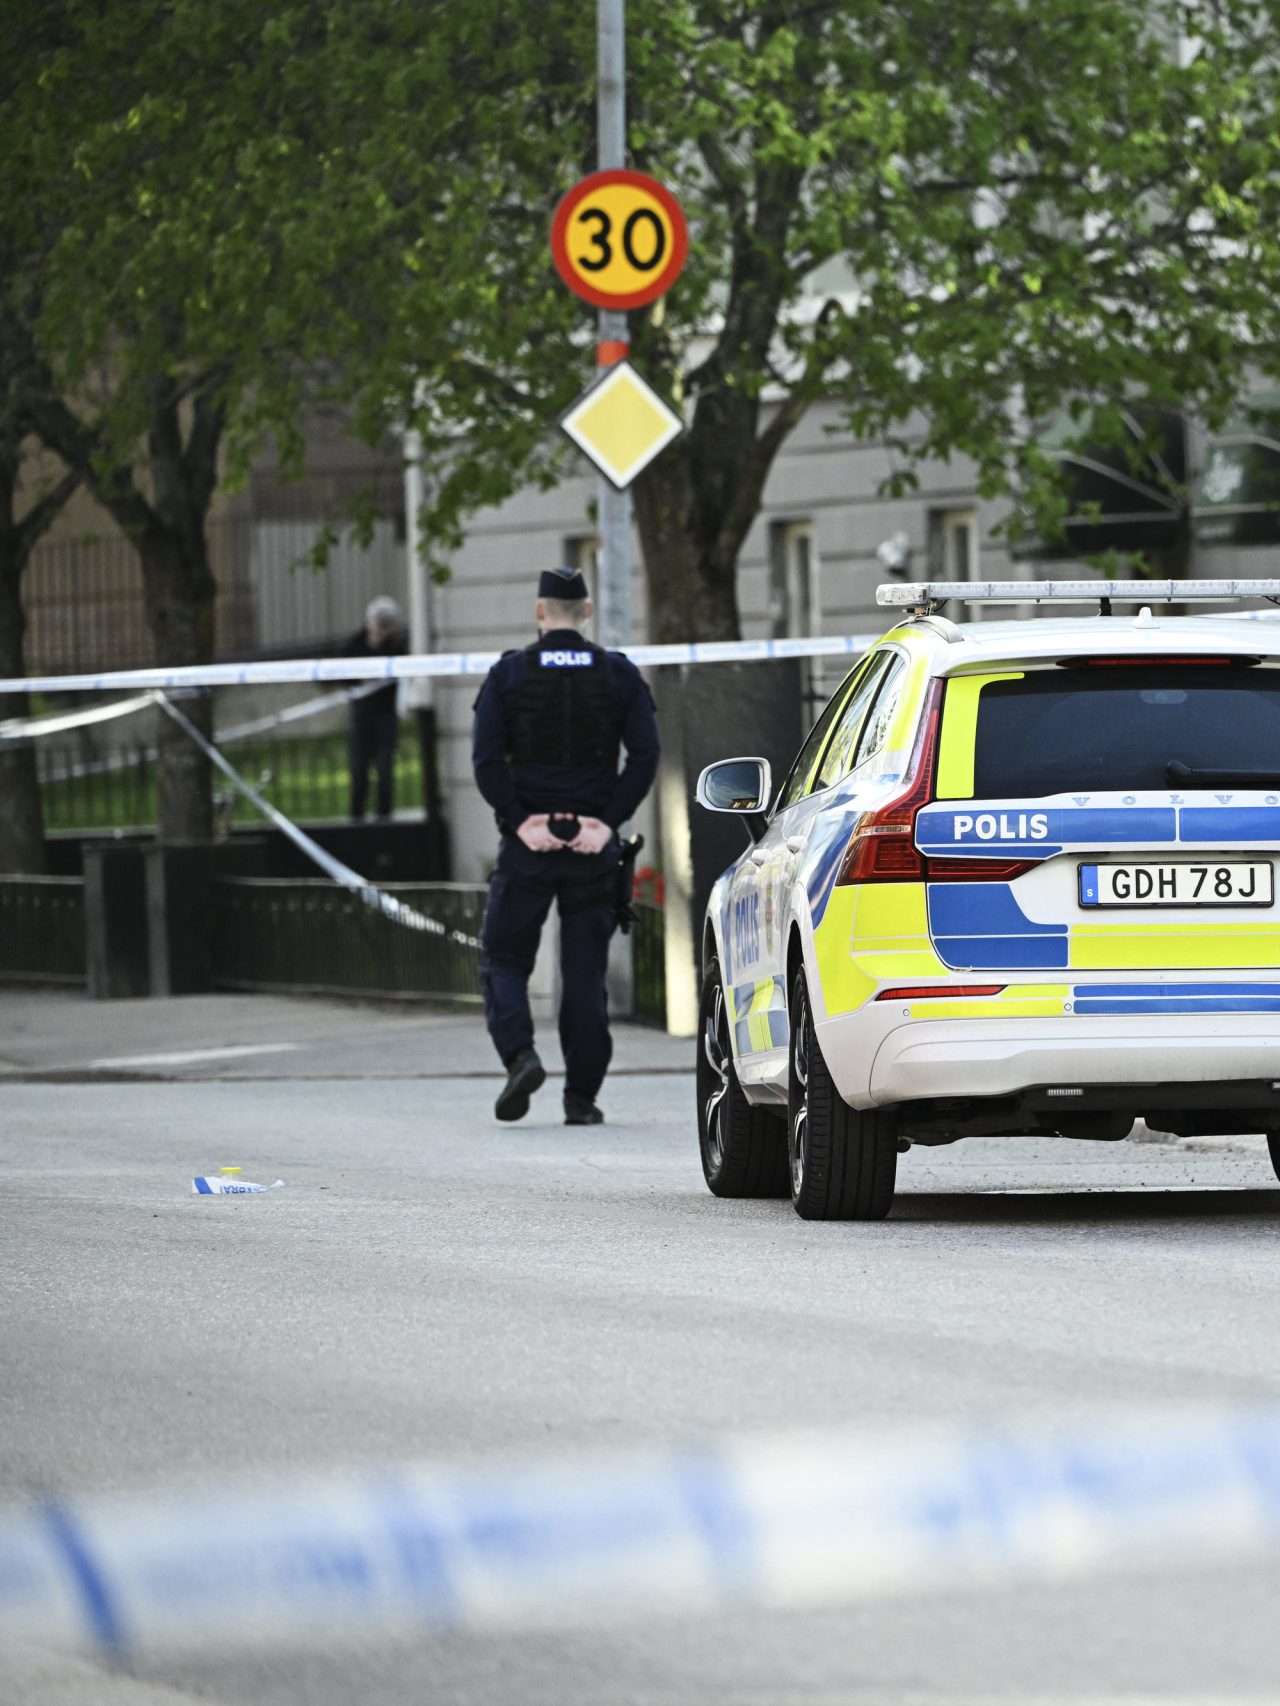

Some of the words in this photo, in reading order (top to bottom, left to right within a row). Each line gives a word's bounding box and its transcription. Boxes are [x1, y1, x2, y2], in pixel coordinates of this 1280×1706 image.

[578, 208, 666, 271] 30
[541, 651, 592, 666] POLIS
[1072, 793, 1280, 806] VOLVO
[954, 814, 1048, 841] POLIS
[1086, 888, 1094, 898] S
[1111, 868, 1178, 899] GDH
[1190, 867, 1256, 899] 78J
[735, 890, 760, 970] POLIS
